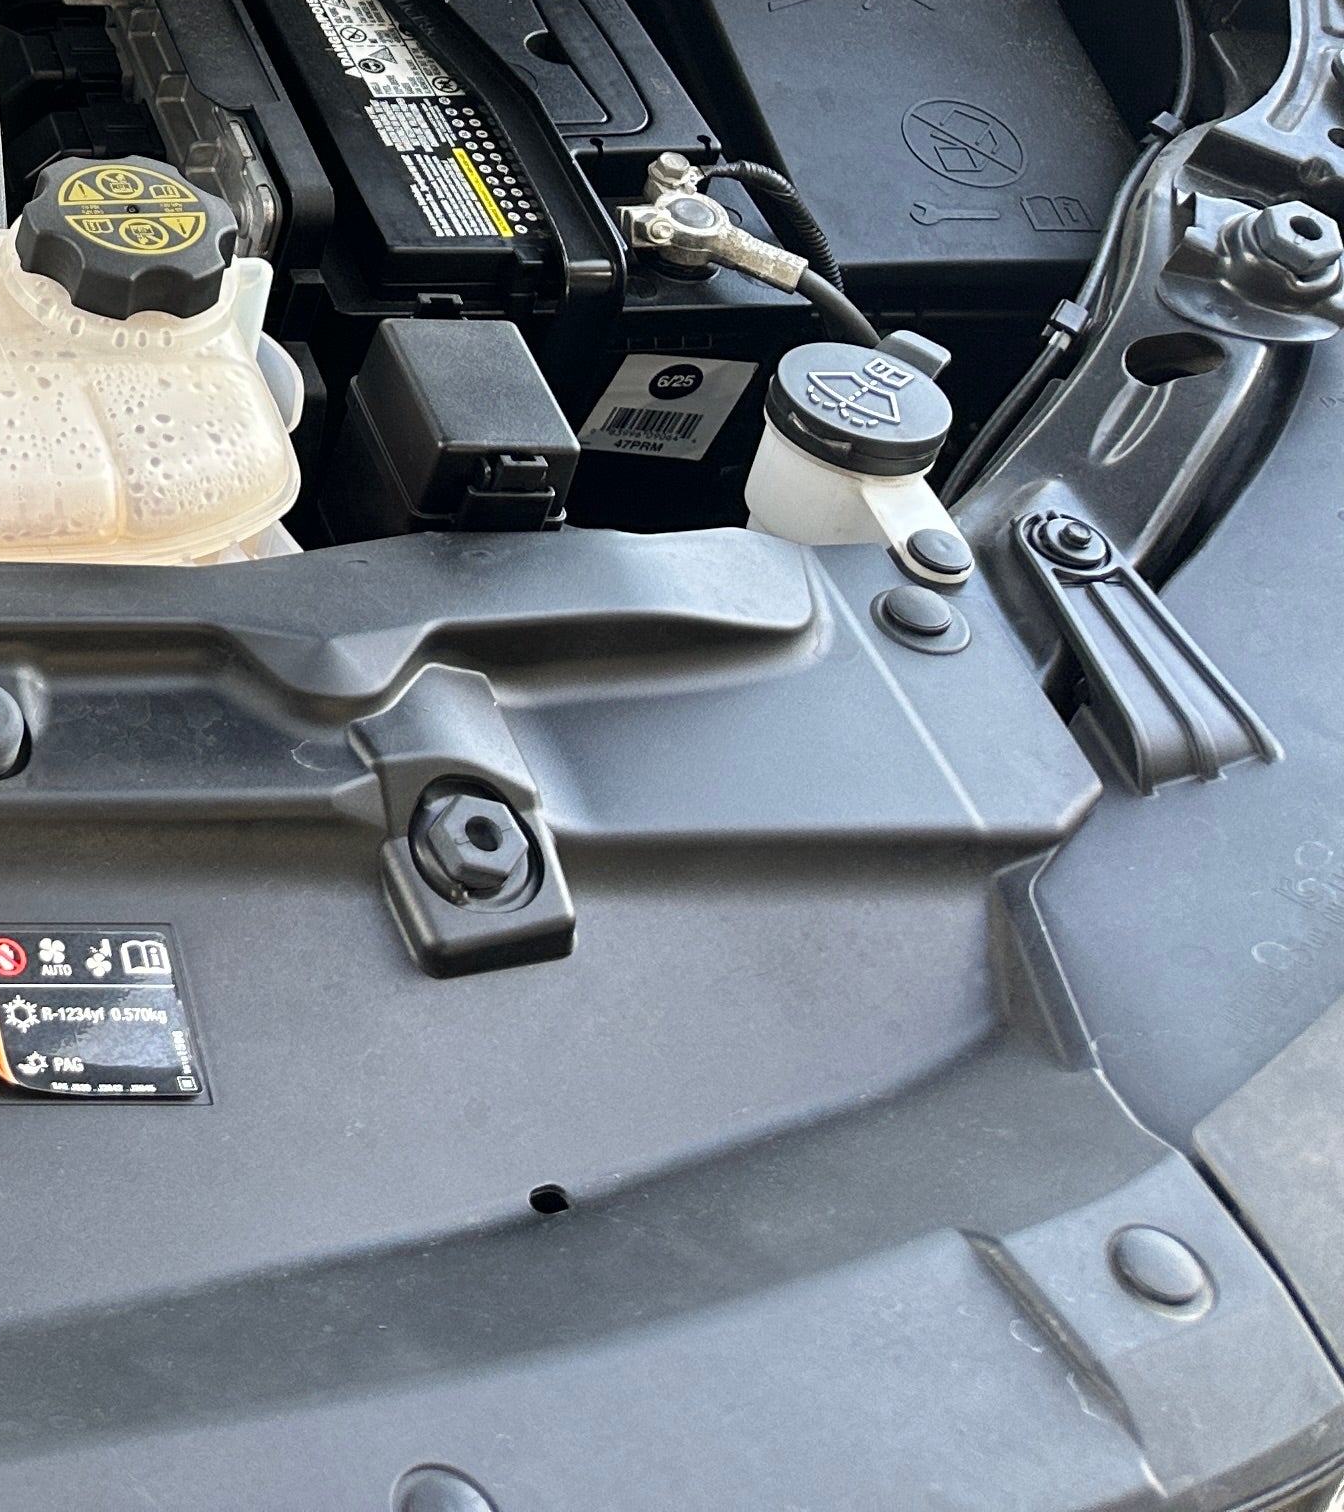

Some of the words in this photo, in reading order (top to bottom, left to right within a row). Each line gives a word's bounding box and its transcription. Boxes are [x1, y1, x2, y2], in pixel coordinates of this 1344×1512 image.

[657, 374, 696, 388] 6/25
[614, 438, 664, 452] 47PRM
[41, 964, 72, 976] AUTO
[52, 1056, 85, 1073] PAG
